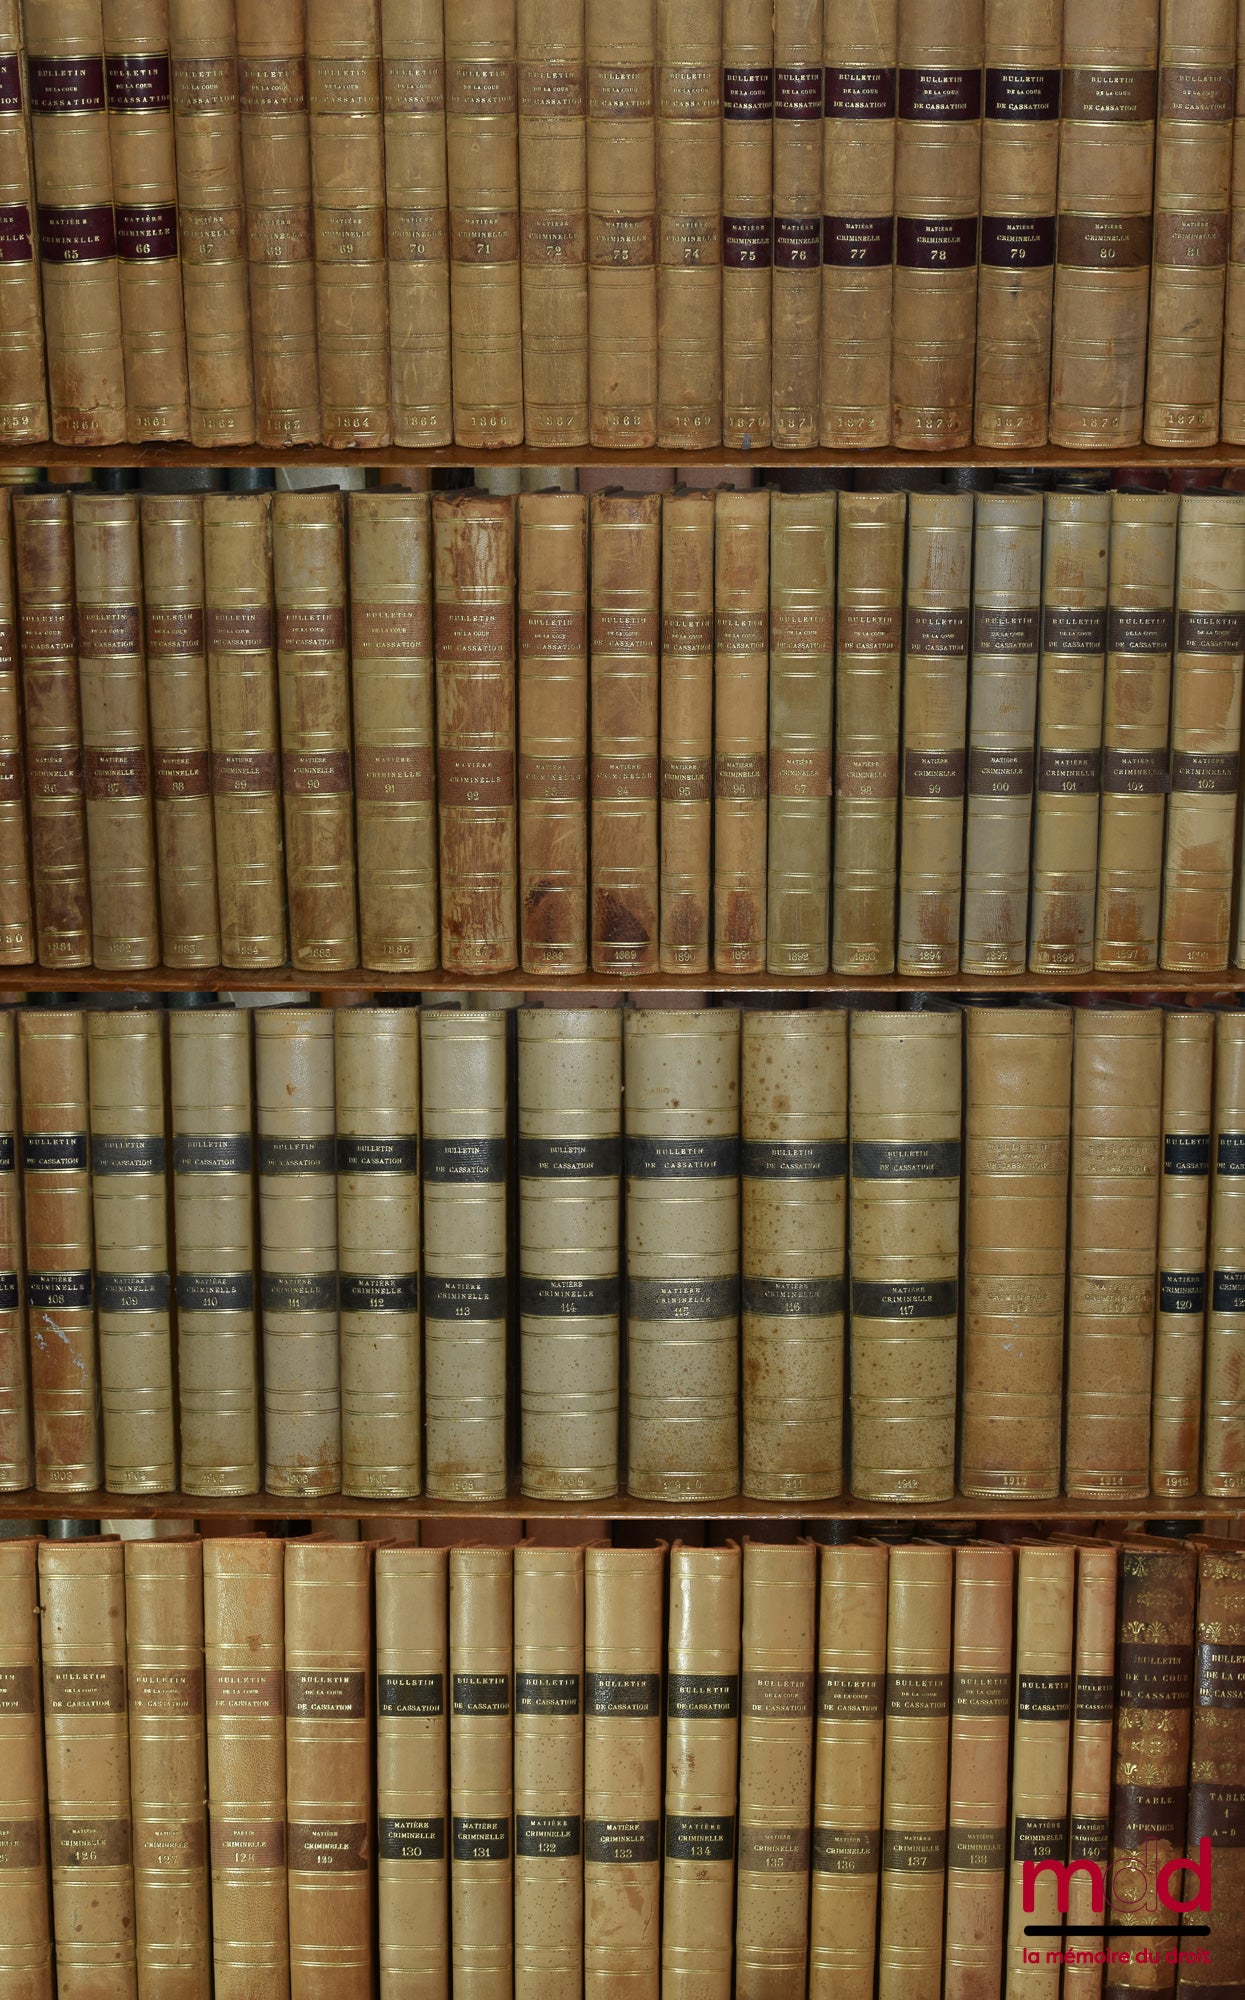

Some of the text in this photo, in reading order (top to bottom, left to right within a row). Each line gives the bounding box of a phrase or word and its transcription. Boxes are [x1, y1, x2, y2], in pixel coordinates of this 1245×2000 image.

[727, 74, 769, 82] BULLETIN
[839, 74, 881, 82] BULLETIN
[42, 98, 100, 107] CASSATION
[116, 95, 170, 103] CASSATION
[846, 101, 887, 109] CASSATION
[118, 228, 171, 236] CRIMINELLE
[726, 237, 769, 246] CRIMINELLE
[836, 234, 881, 242] CRIMINELLE
[917, 236, 961, 244] CRIMINELLE
[996, 234, 1041, 242] CRIMINELLE
[135, 243, 150, 254] 66
[409, 244, 425, 254] 70
[476, 244, 490, 254] 71
[546, 246, 562, 256] 72
[1010, 247, 1027, 258] 79
[1099, 246, 1116, 258] 80
[64, 250, 78, 259] 65
[613, 250, 629, 260] 73
[740, 250, 757, 261] 75
[791, 249, 807, 261] 76
[850, 248, 866, 260] 77
[930, 249, 947, 261] 78
[981, 767, 1023, 775] CRIMINELLE
[307, 780, 320, 789] 90
[384, 784, 396, 793] 91
[733, 784, 746, 794] 96
[928, 784, 941, 794] 99
[992, 782, 1009, 792] 100
[1061, 781, 1077, 791] 101
[678, 786, 691, 796] 95
[860, 786, 872, 795] 98
[466, 791, 480, 800] 92
[28, 1138, 77, 1146] BULLETIN
[357, 1145, 393, 1153] BULLETIN
[38, 1157, 79, 1166] CASSATION
[361, 1156, 402, 1166] CASSATION
[553, 1161, 594, 1170] CASSATION
[449, 1165, 489, 1174] CASSATION
[352, 1286, 402, 1295] CRIMINELLE
[48, 1294, 65, 1304] 108
[437, 1292, 489, 1300] CRIMINELLE
[881, 1295, 933, 1303] CRIMINELLE
[202, 1297, 218, 1307] 110
[369, 1298, 384, 1307] 112
[1175, 1299, 1192, 1310] 120
[455, 1305, 470, 1316] 113
[561, 1302, 576, 1313] 114
[674, 1306, 689, 1316] 115
[898, 1305, 914, 1315] 117
[1137, 1656, 1182, 1665] BULLETIN
[526, 1678, 575, 1686] BULLETIN
[599, 1680, 647, 1688] BULLETIN
[757, 1679, 805, 1688] BULLETIN
[827, 1680, 877, 1688] BULLETIN
[895, 1679, 944, 1687] BULLETIN
[679, 1686, 730, 1694] BULLETIN
[1136, 1691, 1189, 1700] CASSATION
[64, 1700, 110, 1708] CASSATION
[467, 1702, 510, 1710] CASSATION
[535, 1698, 577, 1706] CASSATION
[607, 1702, 649, 1710] CASSATION
[687, 1702, 730, 1710] CASSATION
[903, 1701, 946, 1709] CASSATION
[310, 1703, 352, 1711] CASSATION
[396, 1704, 440, 1712] CASSATION
[1032, 1703, 1070, 1711] CASSATION
[525, 1830, 571, 1838] CRIMINELLE
[600, 1835, 645, 1843] CRIMINELLE
[304, 1842, 349, 1850] CRIMINELLE
[538, 1842, 556, 1853] 132
[893, 1844, 939, 1852] CRIMINELLE
[75, 1851, 97, 1860] 126
[400, 1847, 422, 1857] 130
[472, 1848, 490, 1857] 131
[614, 1848, 632, 1858] 133
[690, 1847, 711, 1857] 134
[826, 1847, 871, 1855] CRIMINELLE
[1033, 1847, 1051, 1856] 139
[764, 1857, 784, 1867] 135
[836, 1860, 855, 1870] 136
[907, 1856, 927, 1866] 137
